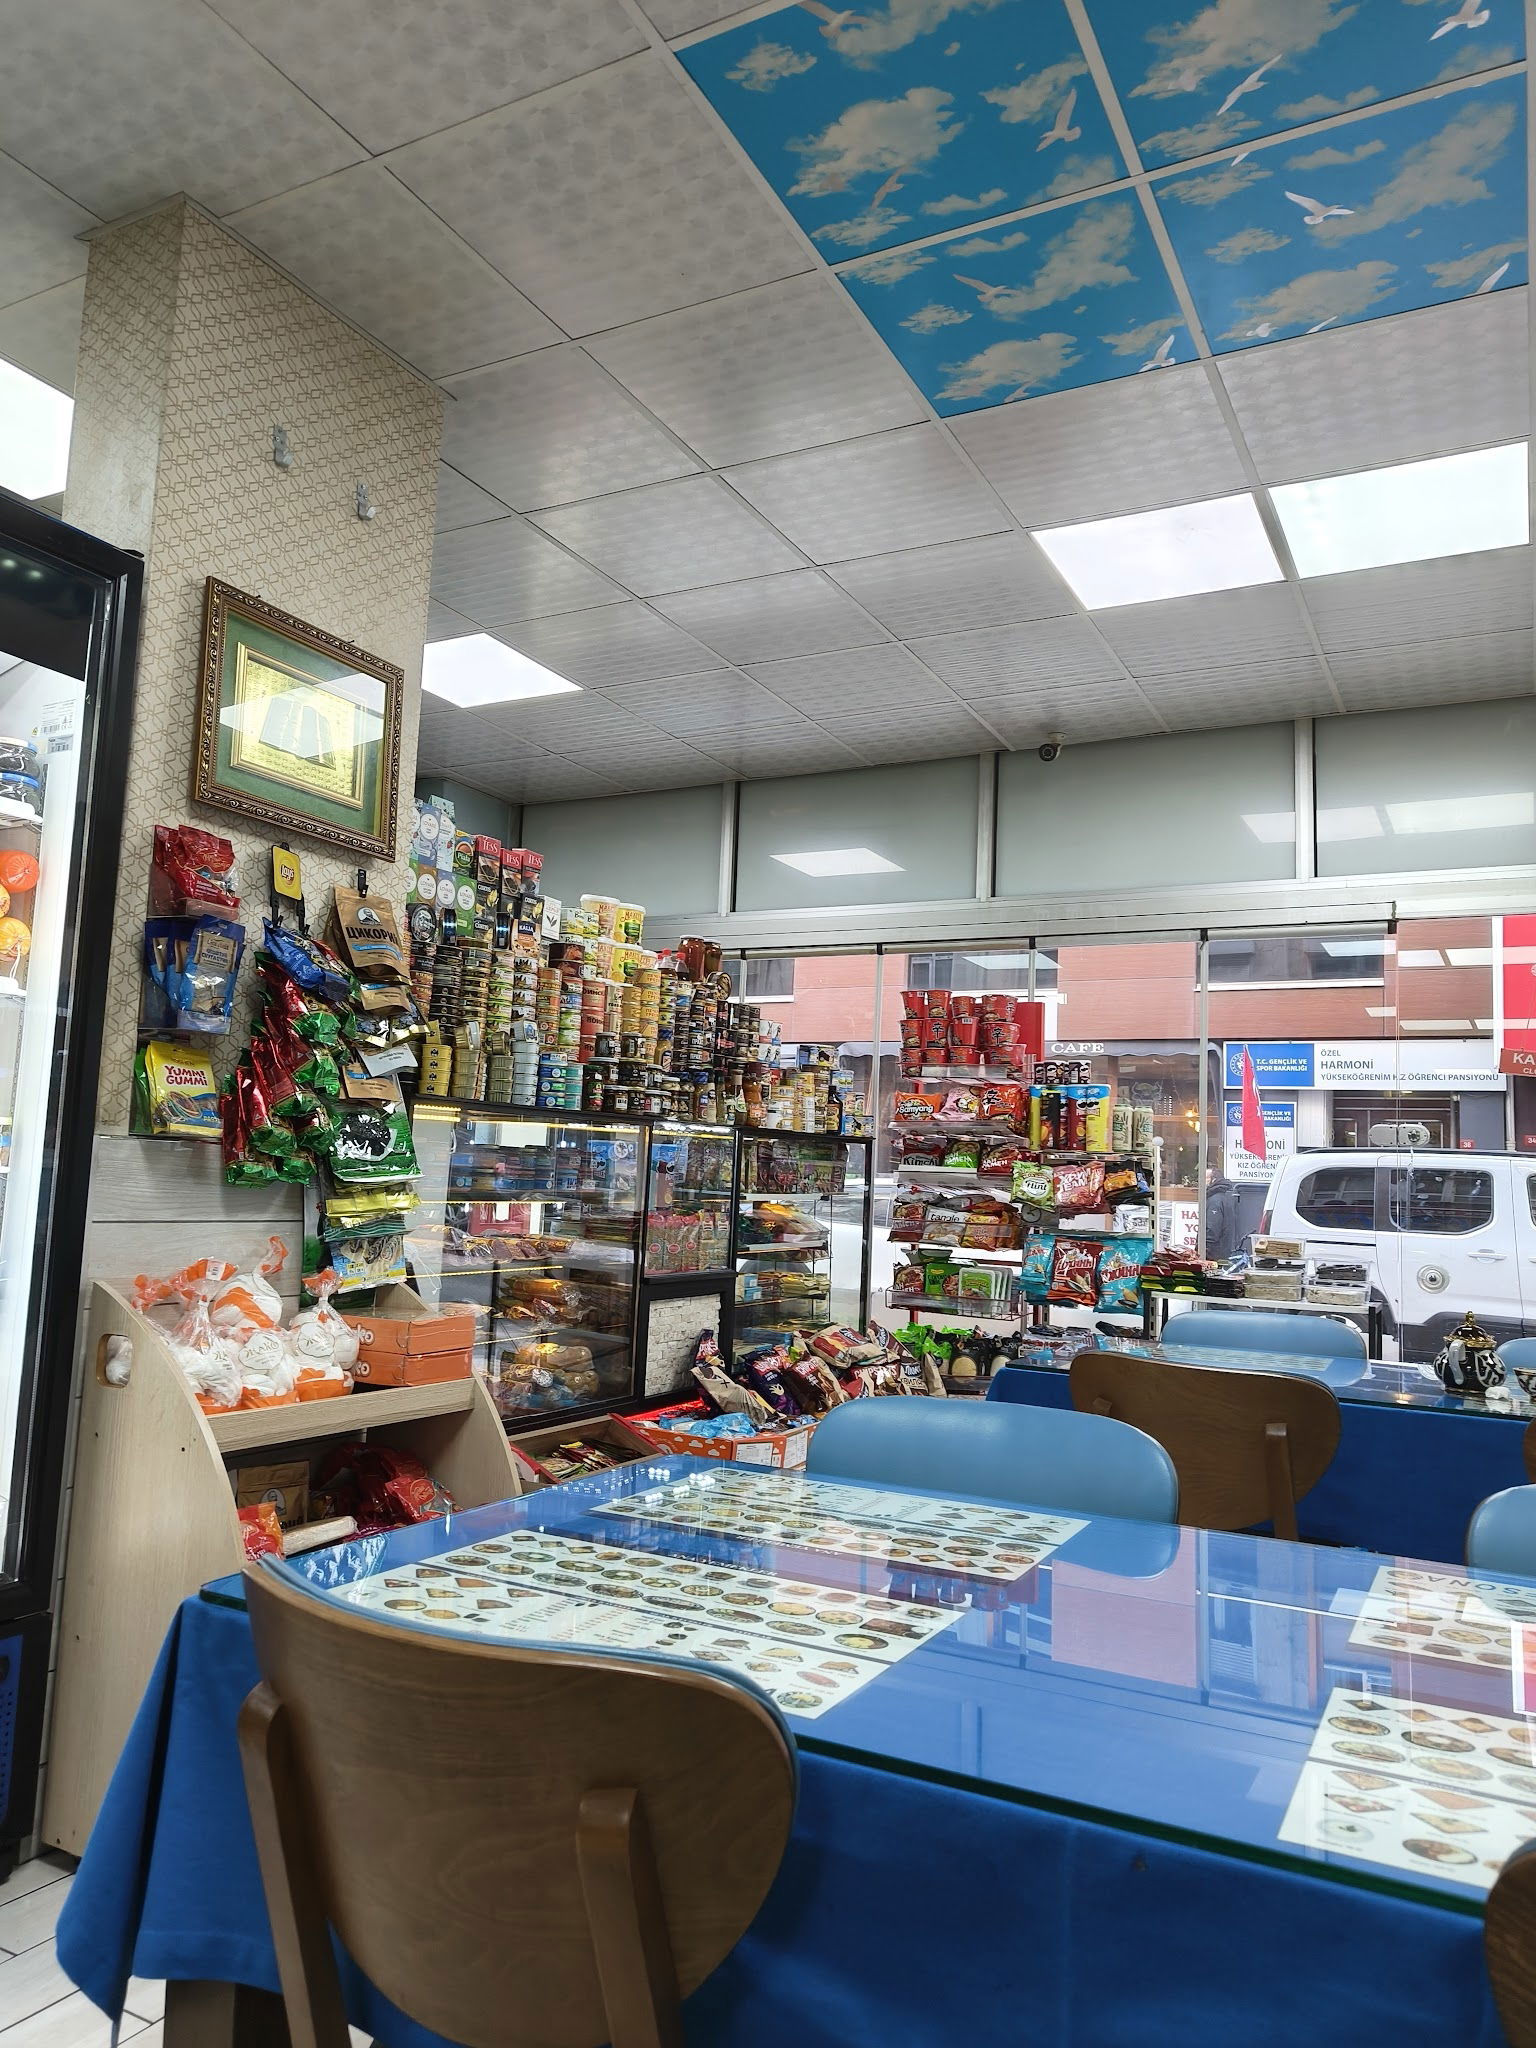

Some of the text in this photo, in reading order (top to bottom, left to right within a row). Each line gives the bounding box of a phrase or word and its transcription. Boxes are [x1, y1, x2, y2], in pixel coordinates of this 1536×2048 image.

[483, 839, 498, 854] TESS
[506, 853, 520, 867] TESS
[528, 854, 543, 868] TESS
[1050, 1042, 1105, 1054] CAFE
[1270, 1058, 1299, 1066] GENÇLİK
[1320, 1059, 1374, 1070] HARMONİ
[899, 1103, 934, 1115] Samyang
